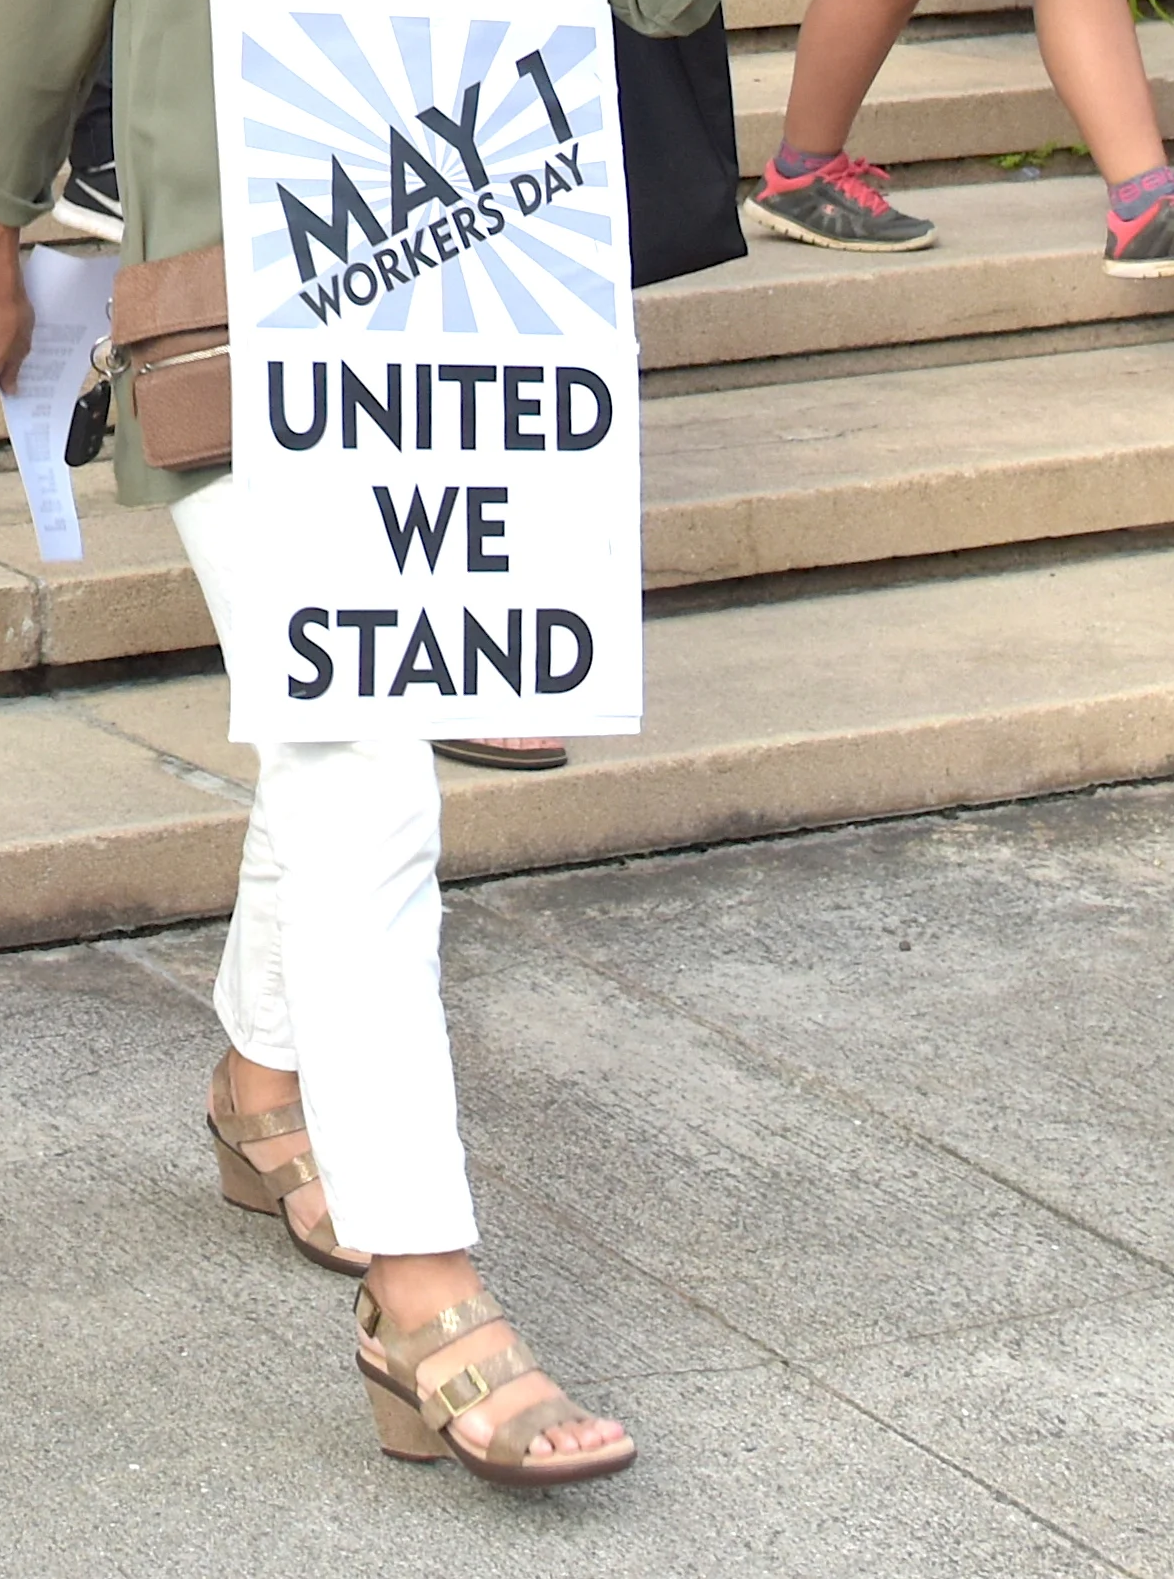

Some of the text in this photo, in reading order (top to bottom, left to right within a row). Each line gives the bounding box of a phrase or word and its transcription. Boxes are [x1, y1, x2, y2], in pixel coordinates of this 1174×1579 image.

[276, 49, 575, 284] MAY 1
[299, 142, 585, 327] WORKERS DAY
[267, 359, 614, 453] UNITED
[372, 484, 510, 575] WE
[287, 606, 595, 701] STAND
